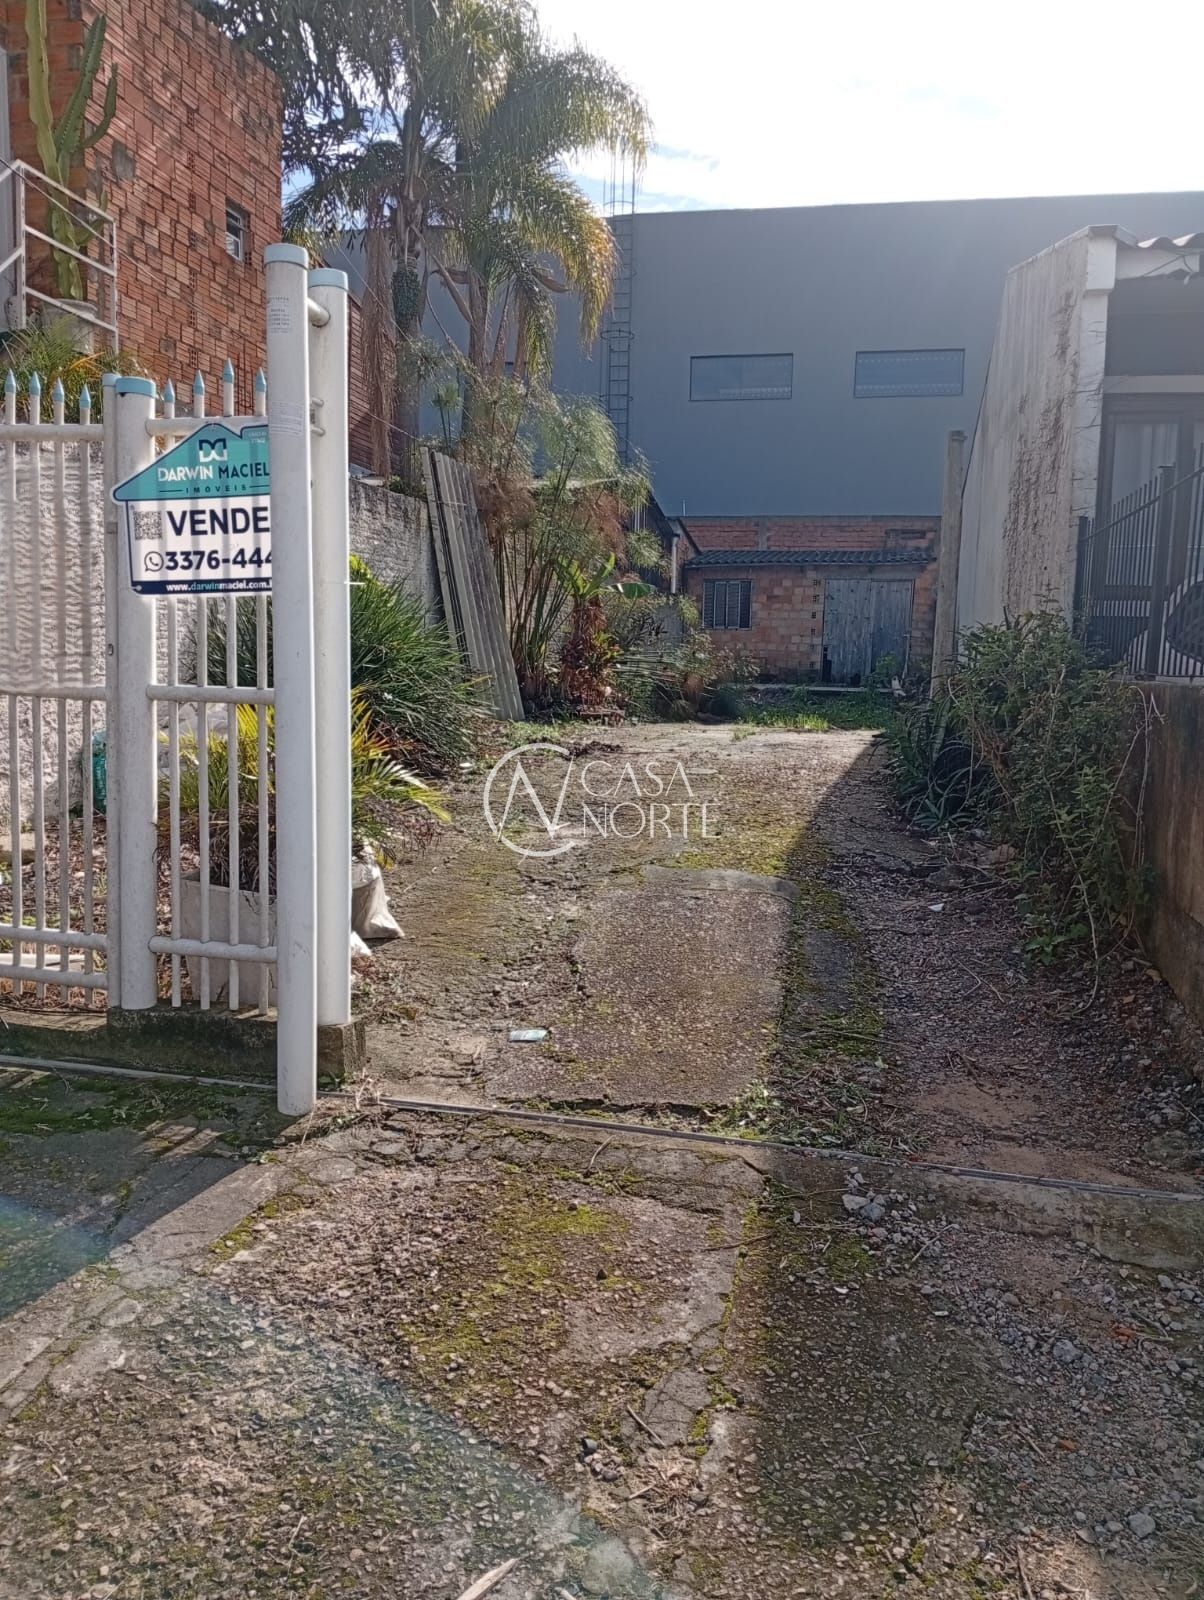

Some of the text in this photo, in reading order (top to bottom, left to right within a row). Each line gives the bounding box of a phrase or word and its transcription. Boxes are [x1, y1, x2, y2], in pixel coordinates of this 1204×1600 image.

[157, 462, 270, 482] DARWIN MACIEL
[167, 506, 270, 536] VENDE
